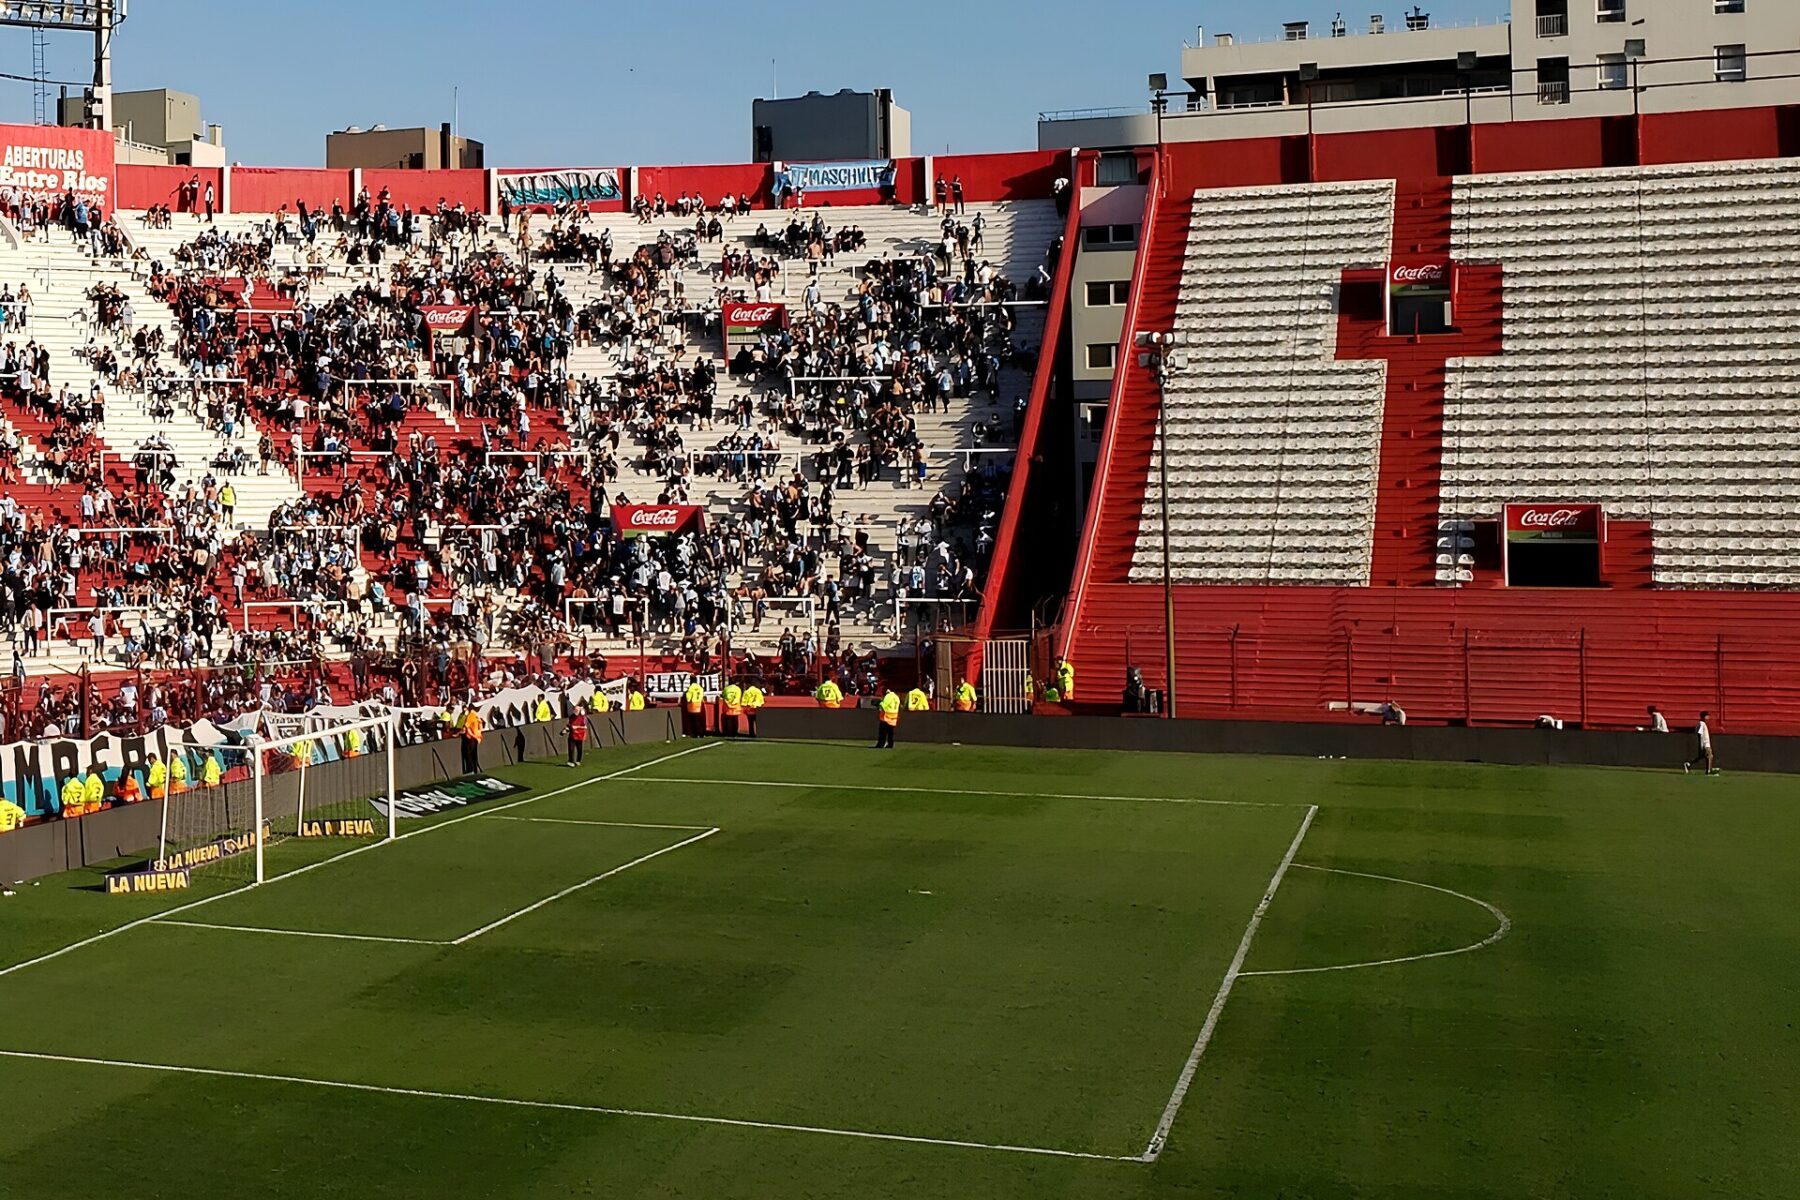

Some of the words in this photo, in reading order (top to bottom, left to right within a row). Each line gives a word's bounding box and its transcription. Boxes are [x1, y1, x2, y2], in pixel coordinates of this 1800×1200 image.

[4, 145, 84, 170] ABERTURAS
[0, 166, 58, 189] Entre
[62, 170, 108, 191] Ríos
[303, 821, 323, 837] LA
[169, 853, 183, 870] LA
[185, 843, 220, 866] NUEVA
[109, 876, 130, 893] LA
[134, 871, 188, 892] NUEVA
